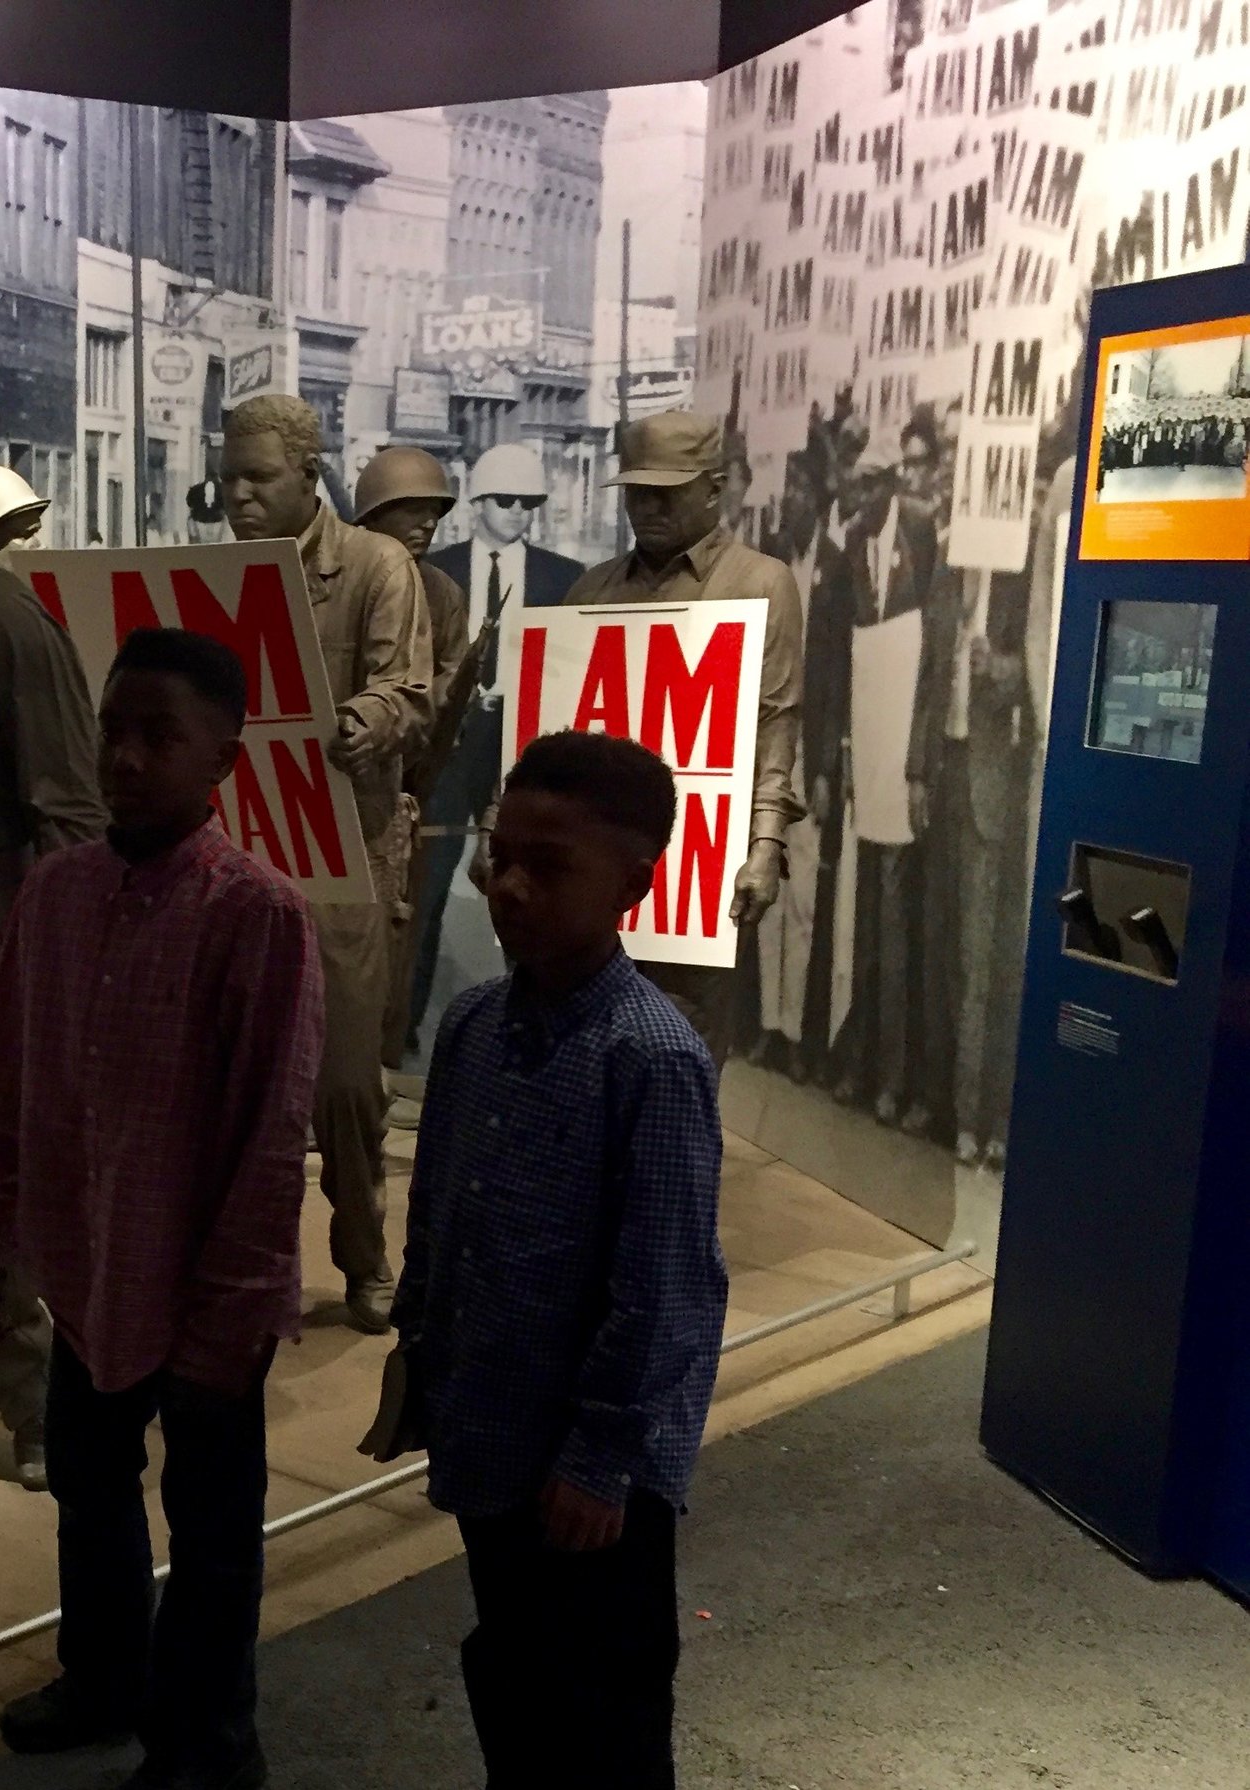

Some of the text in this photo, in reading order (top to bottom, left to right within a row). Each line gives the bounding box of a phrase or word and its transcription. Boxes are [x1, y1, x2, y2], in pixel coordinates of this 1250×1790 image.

[987, 23, 1040, 111] AM
[941, 176, 989, 263] AM
[423, 314, 534, 354] LOANS
[983, 337, 1043, 418] AM
[516, 621, 746, 769] I AM
[207, 738, 348, 879] AN
